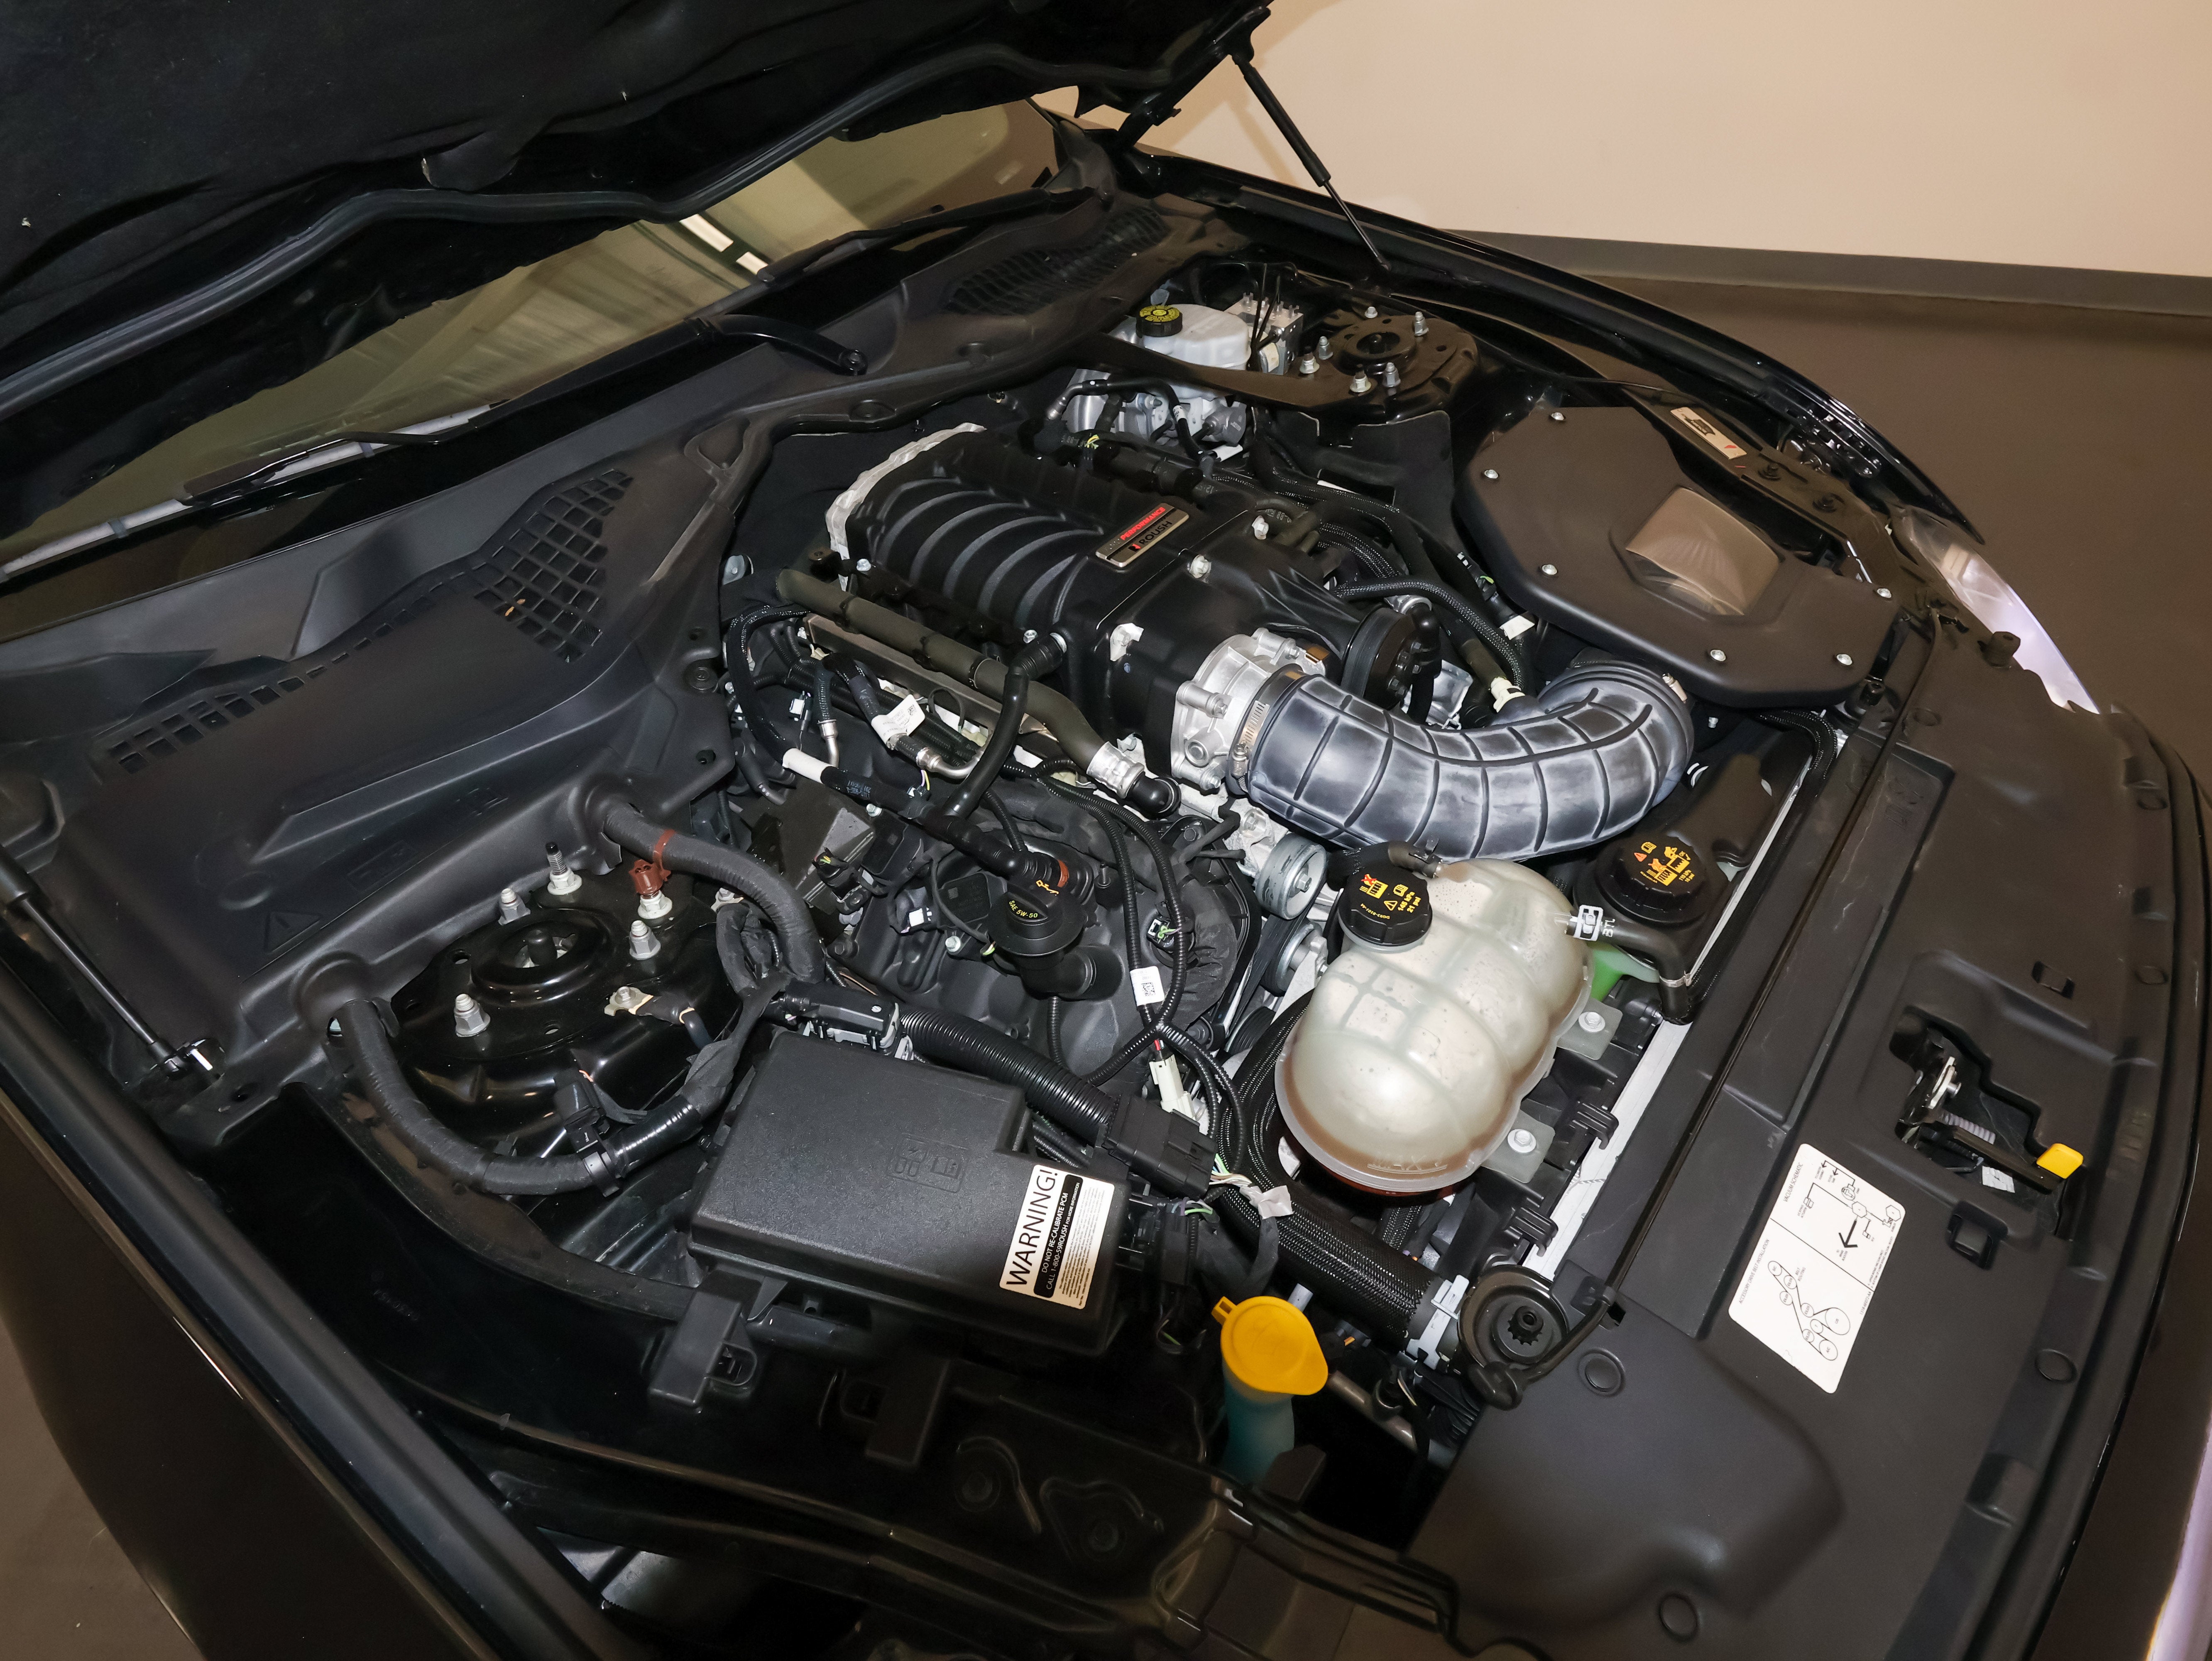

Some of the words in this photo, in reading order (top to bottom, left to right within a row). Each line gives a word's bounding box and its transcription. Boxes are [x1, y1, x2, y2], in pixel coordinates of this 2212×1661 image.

[1120, 507, 1166, 540] PERFORMANCE
[1139, 521, 1172, 545] ROUSH
[1009, 900, 1018, 911] SAE
[1017, 909, 1038, 918] 5W-50
[1407, 905, 1415, 913] 21
[1412, 896, 1422, 906] psi
[1783, 1184, 1794, 1202] VACUUM
[1791, 1162, 1803, 1185] SCHEMATIC
[1006, 1169, 1057, 1285] WARNING!
[1042, 1263, 1049, 1273] DO
[1049, 1206, 1064, 1247] RE-CALIBRATE
[1060, 1193, 1068, 1206] PCM
[1046, 1274, 1055, 1289] CALL
[1051, 1225, 1068, 1271] 1-800-59ROUSH
[1071, 1183, 1080, 1206] INFORMATION
[1739, 1283, 1750, 1304] ACCESSORY
[1757, 1239, 1769, 1264] INSTALLATION
[1860, 1291, 1872, 1315] 1318-6E072-AA
